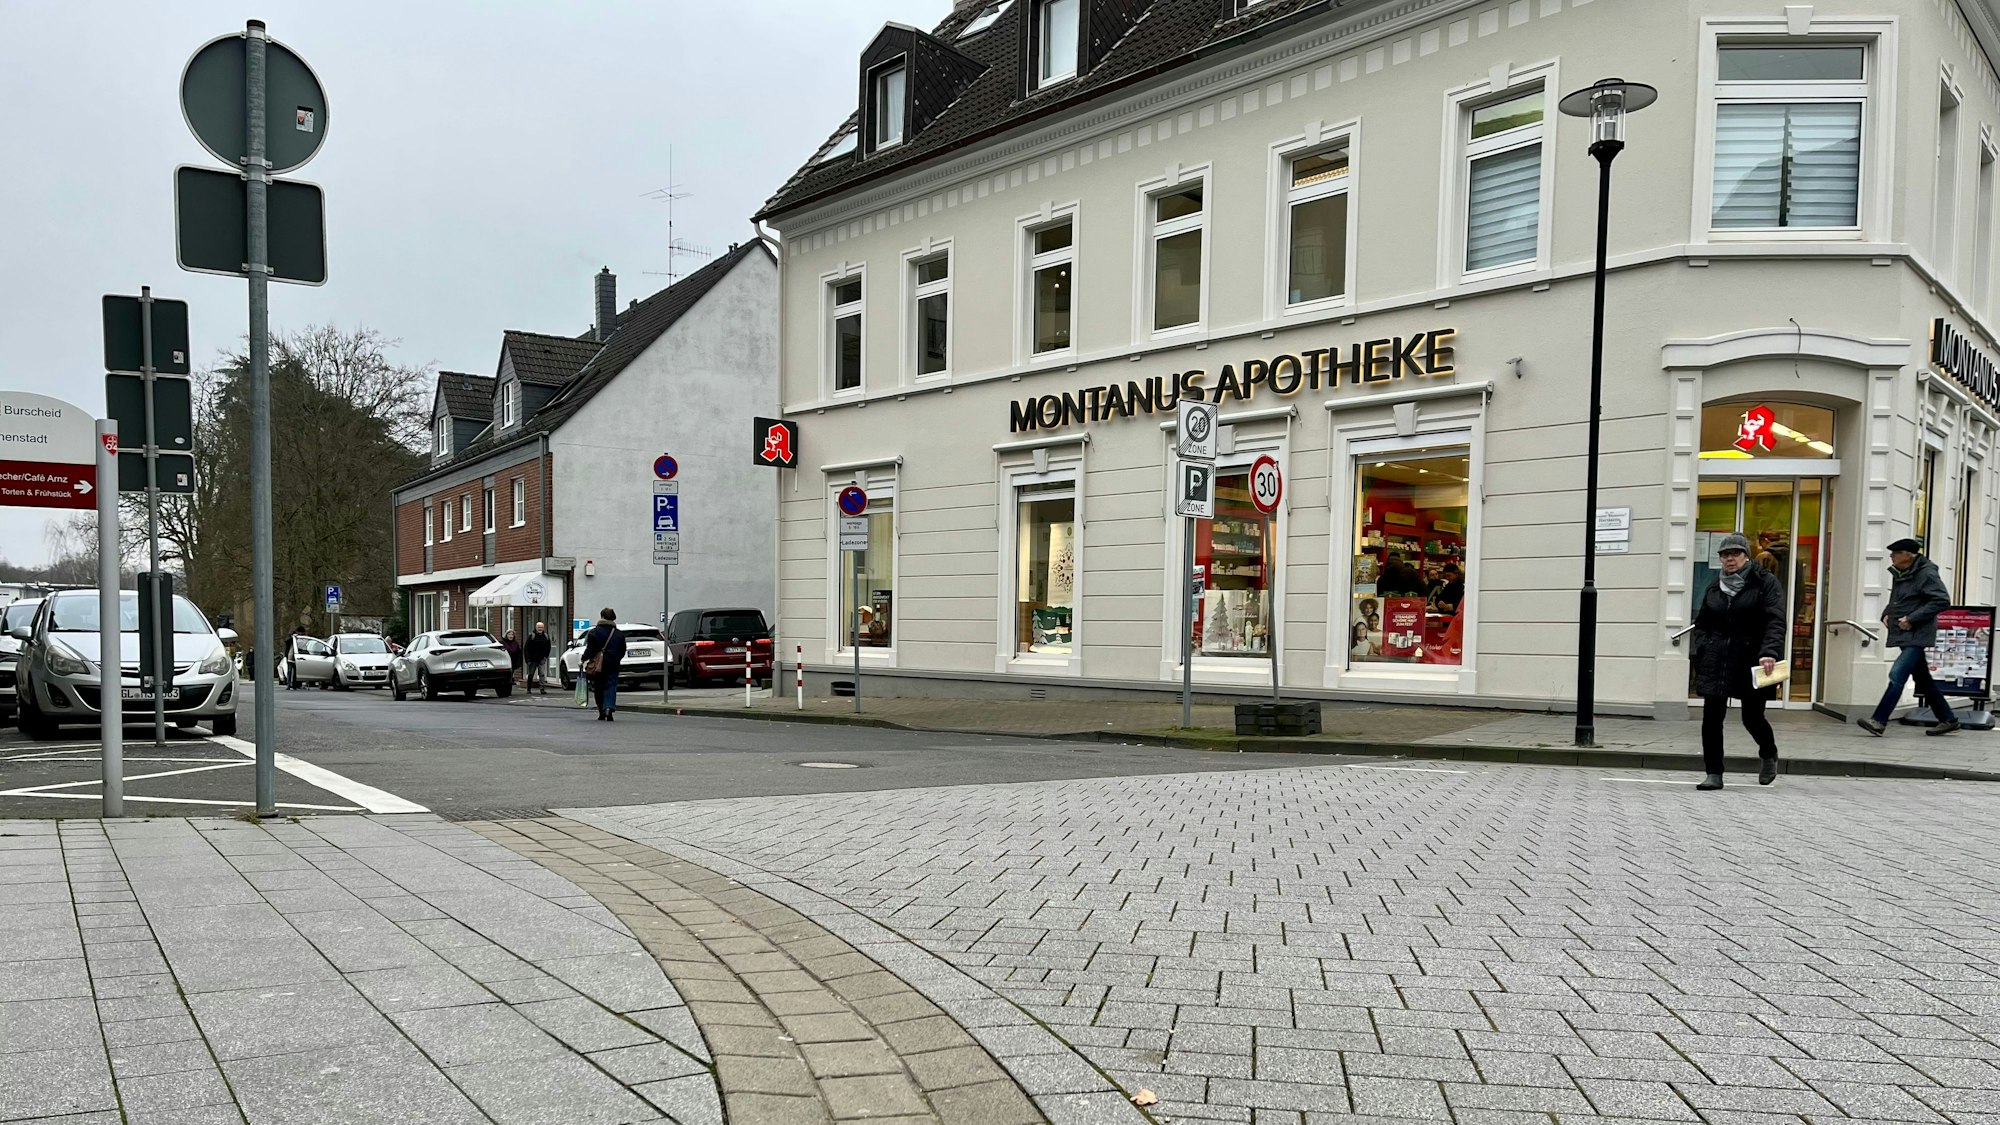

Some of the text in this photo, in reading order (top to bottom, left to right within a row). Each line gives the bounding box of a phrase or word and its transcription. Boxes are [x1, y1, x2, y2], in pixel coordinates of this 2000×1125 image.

[1010, 328, 1455, 432] MONTANUS APOTHEKE
[4, 405, 62, 418] Burscheid
[1191, 415, 1206, 433] 20
[1188, 443, 1207, 455] ZONE
[47, 474, 68, 483] Arnz
[1190, 469, 1204, 497] P
[1257, 471, 1276, 498] 30
[1, 487, 72, 498] Torten & Frühstück
[657, 497, 668, 512] P
[1187, 502, 1205, 513] ZONE
